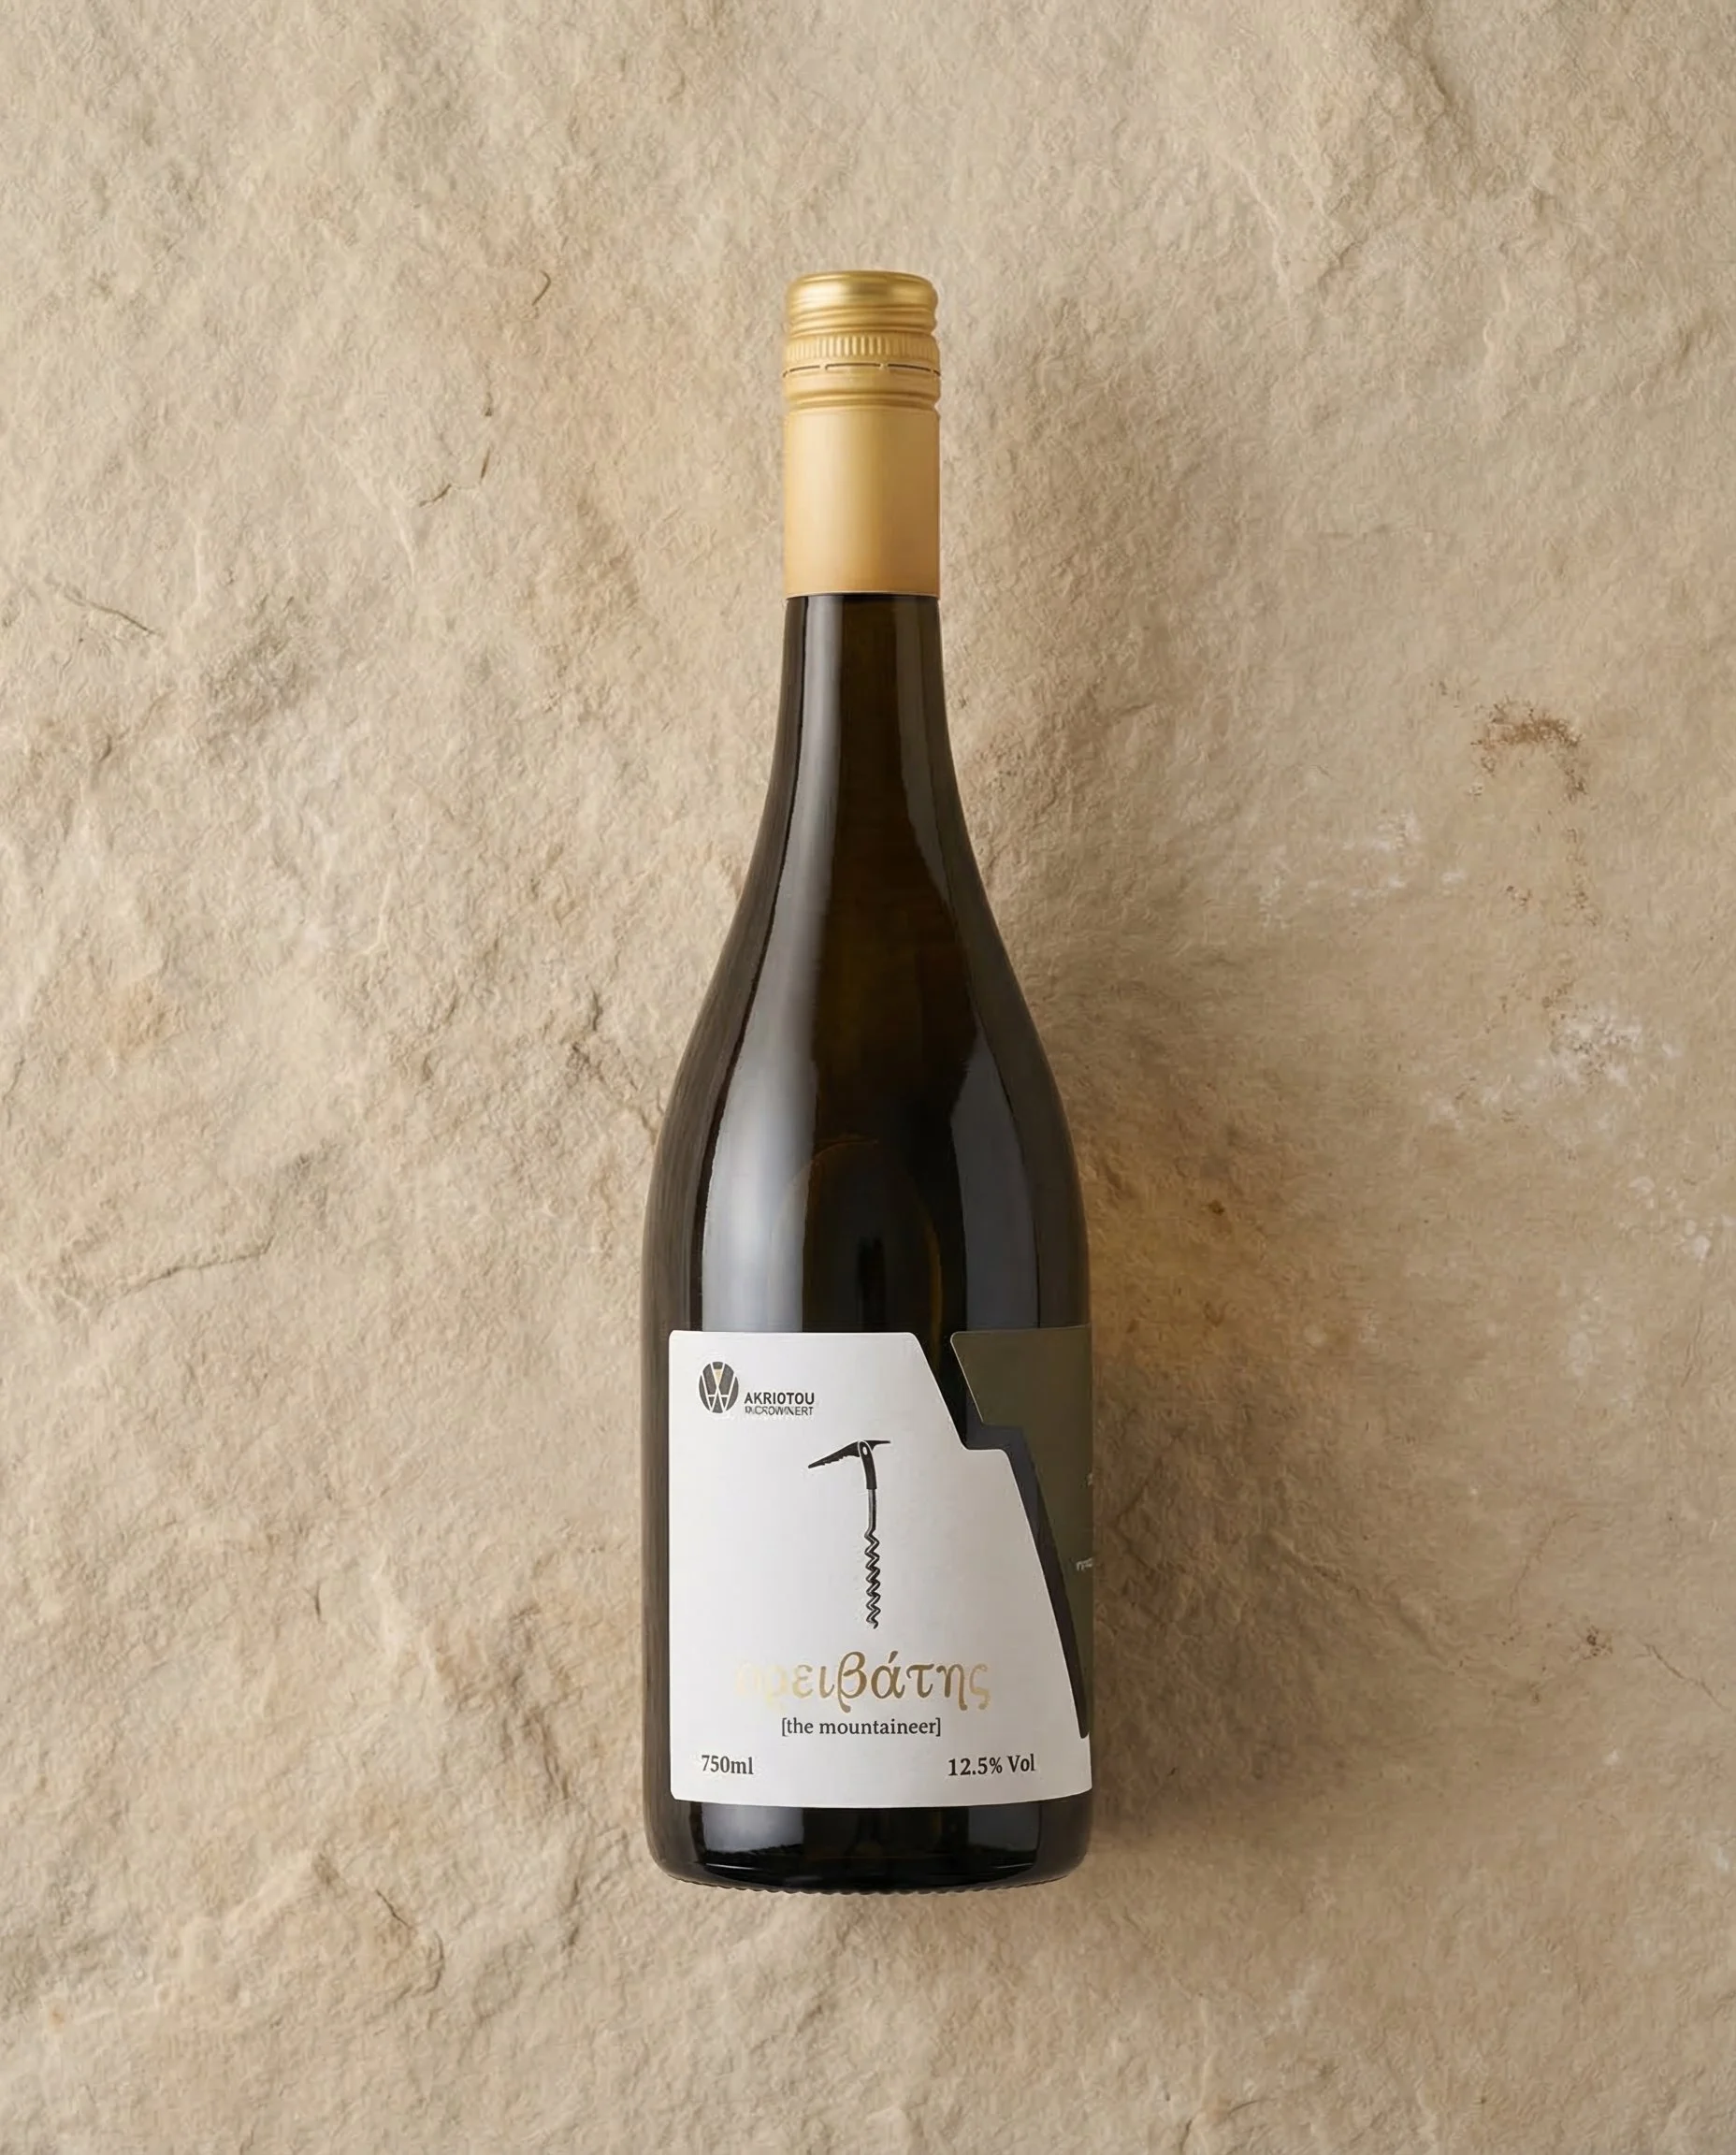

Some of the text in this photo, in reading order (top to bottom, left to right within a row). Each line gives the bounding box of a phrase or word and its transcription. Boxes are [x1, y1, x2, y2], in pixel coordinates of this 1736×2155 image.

[744, 1392, 815, 1405] AKRIOTOU
[781, 1717, 941, 1737] [the mountaineer]
[702, 1754, 754, 1775] 750ml
[948, 1753, 1035, 1777] 12.5% Vol
